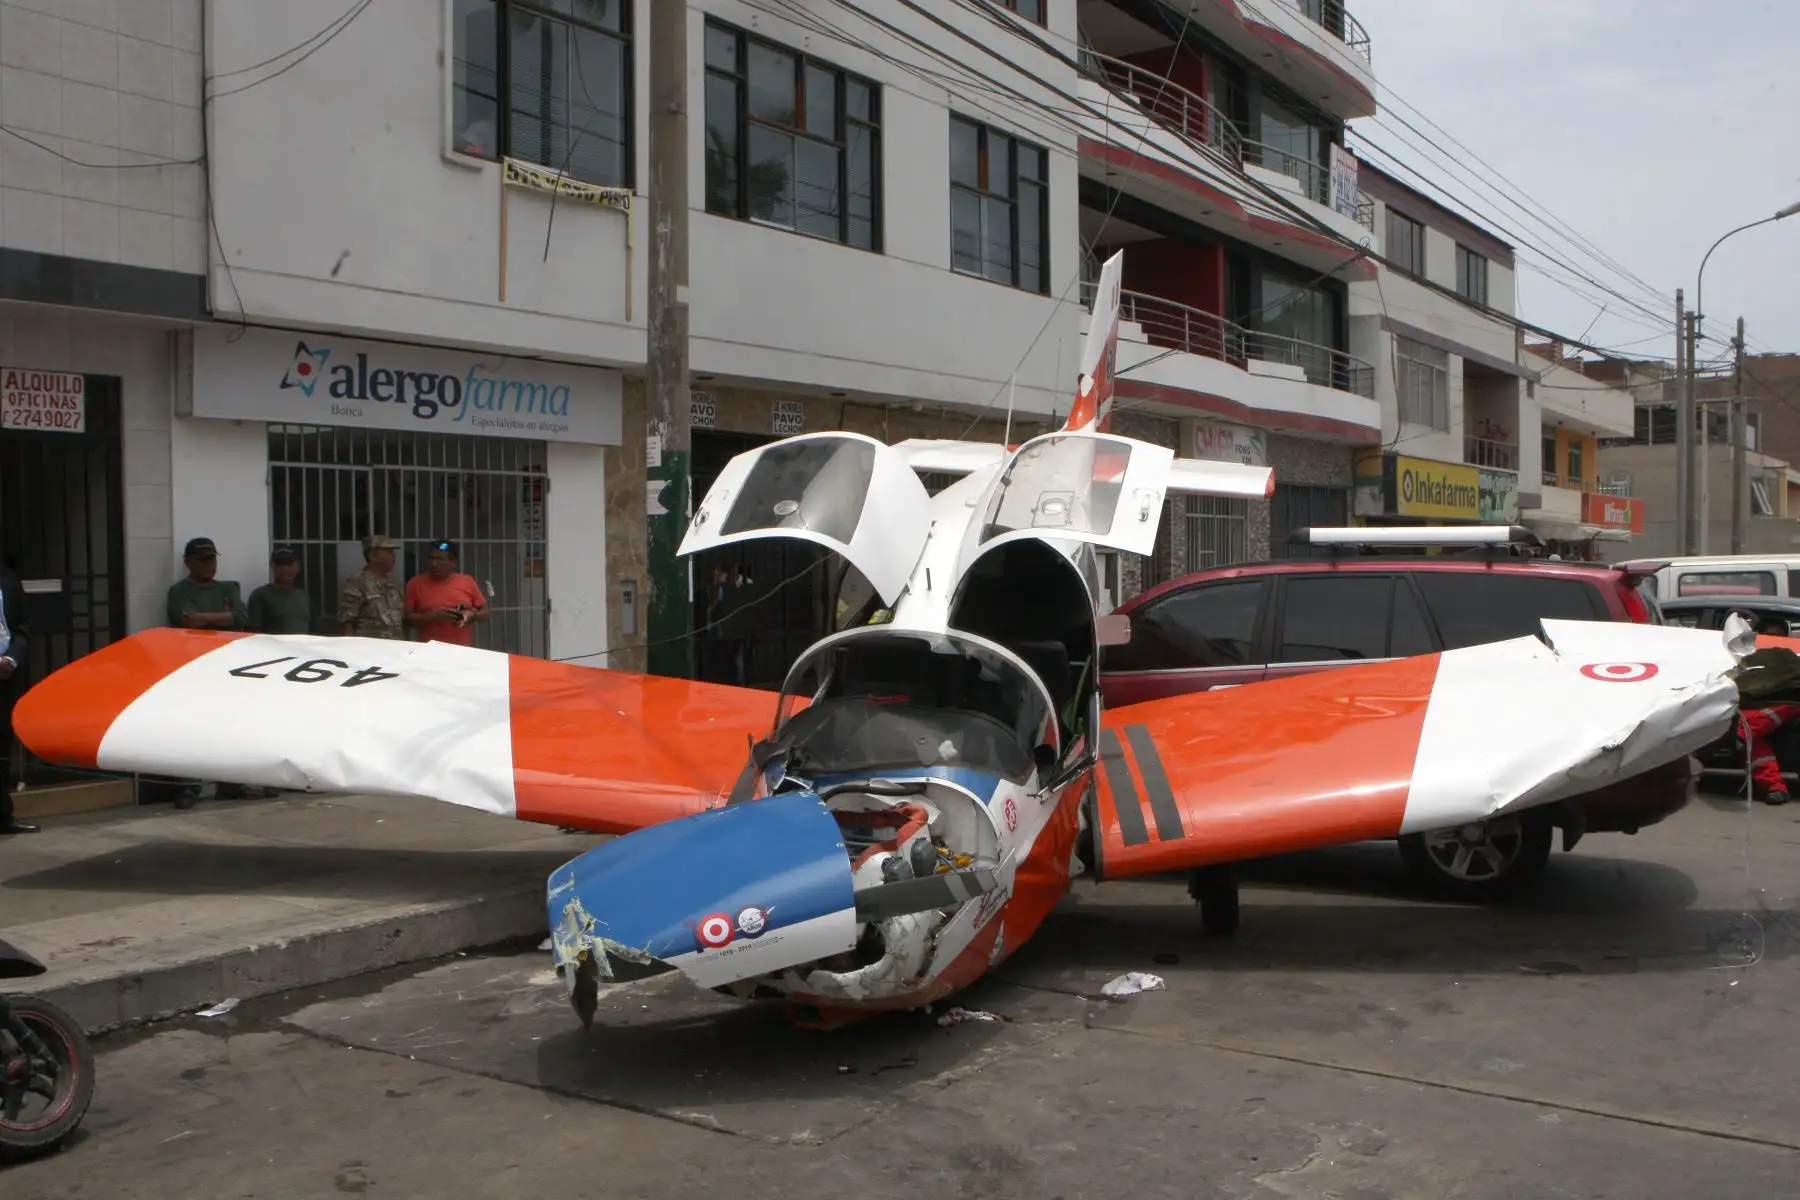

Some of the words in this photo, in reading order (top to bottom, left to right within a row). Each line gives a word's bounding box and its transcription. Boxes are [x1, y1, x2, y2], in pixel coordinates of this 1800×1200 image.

[5, 371, 82, 394] ALQUILO
[329, 352, 571, 422] alergofarma
[8, 392, 78, 409] OFICINAS
[690, 403, 715, 416] AVO
[12, 409, 82, 429] 2749027
[773, 413, 802, 424] PAVO
[1415, 470, 1476, 509] Inkafarma
[228, 656, 401, 688] 497
